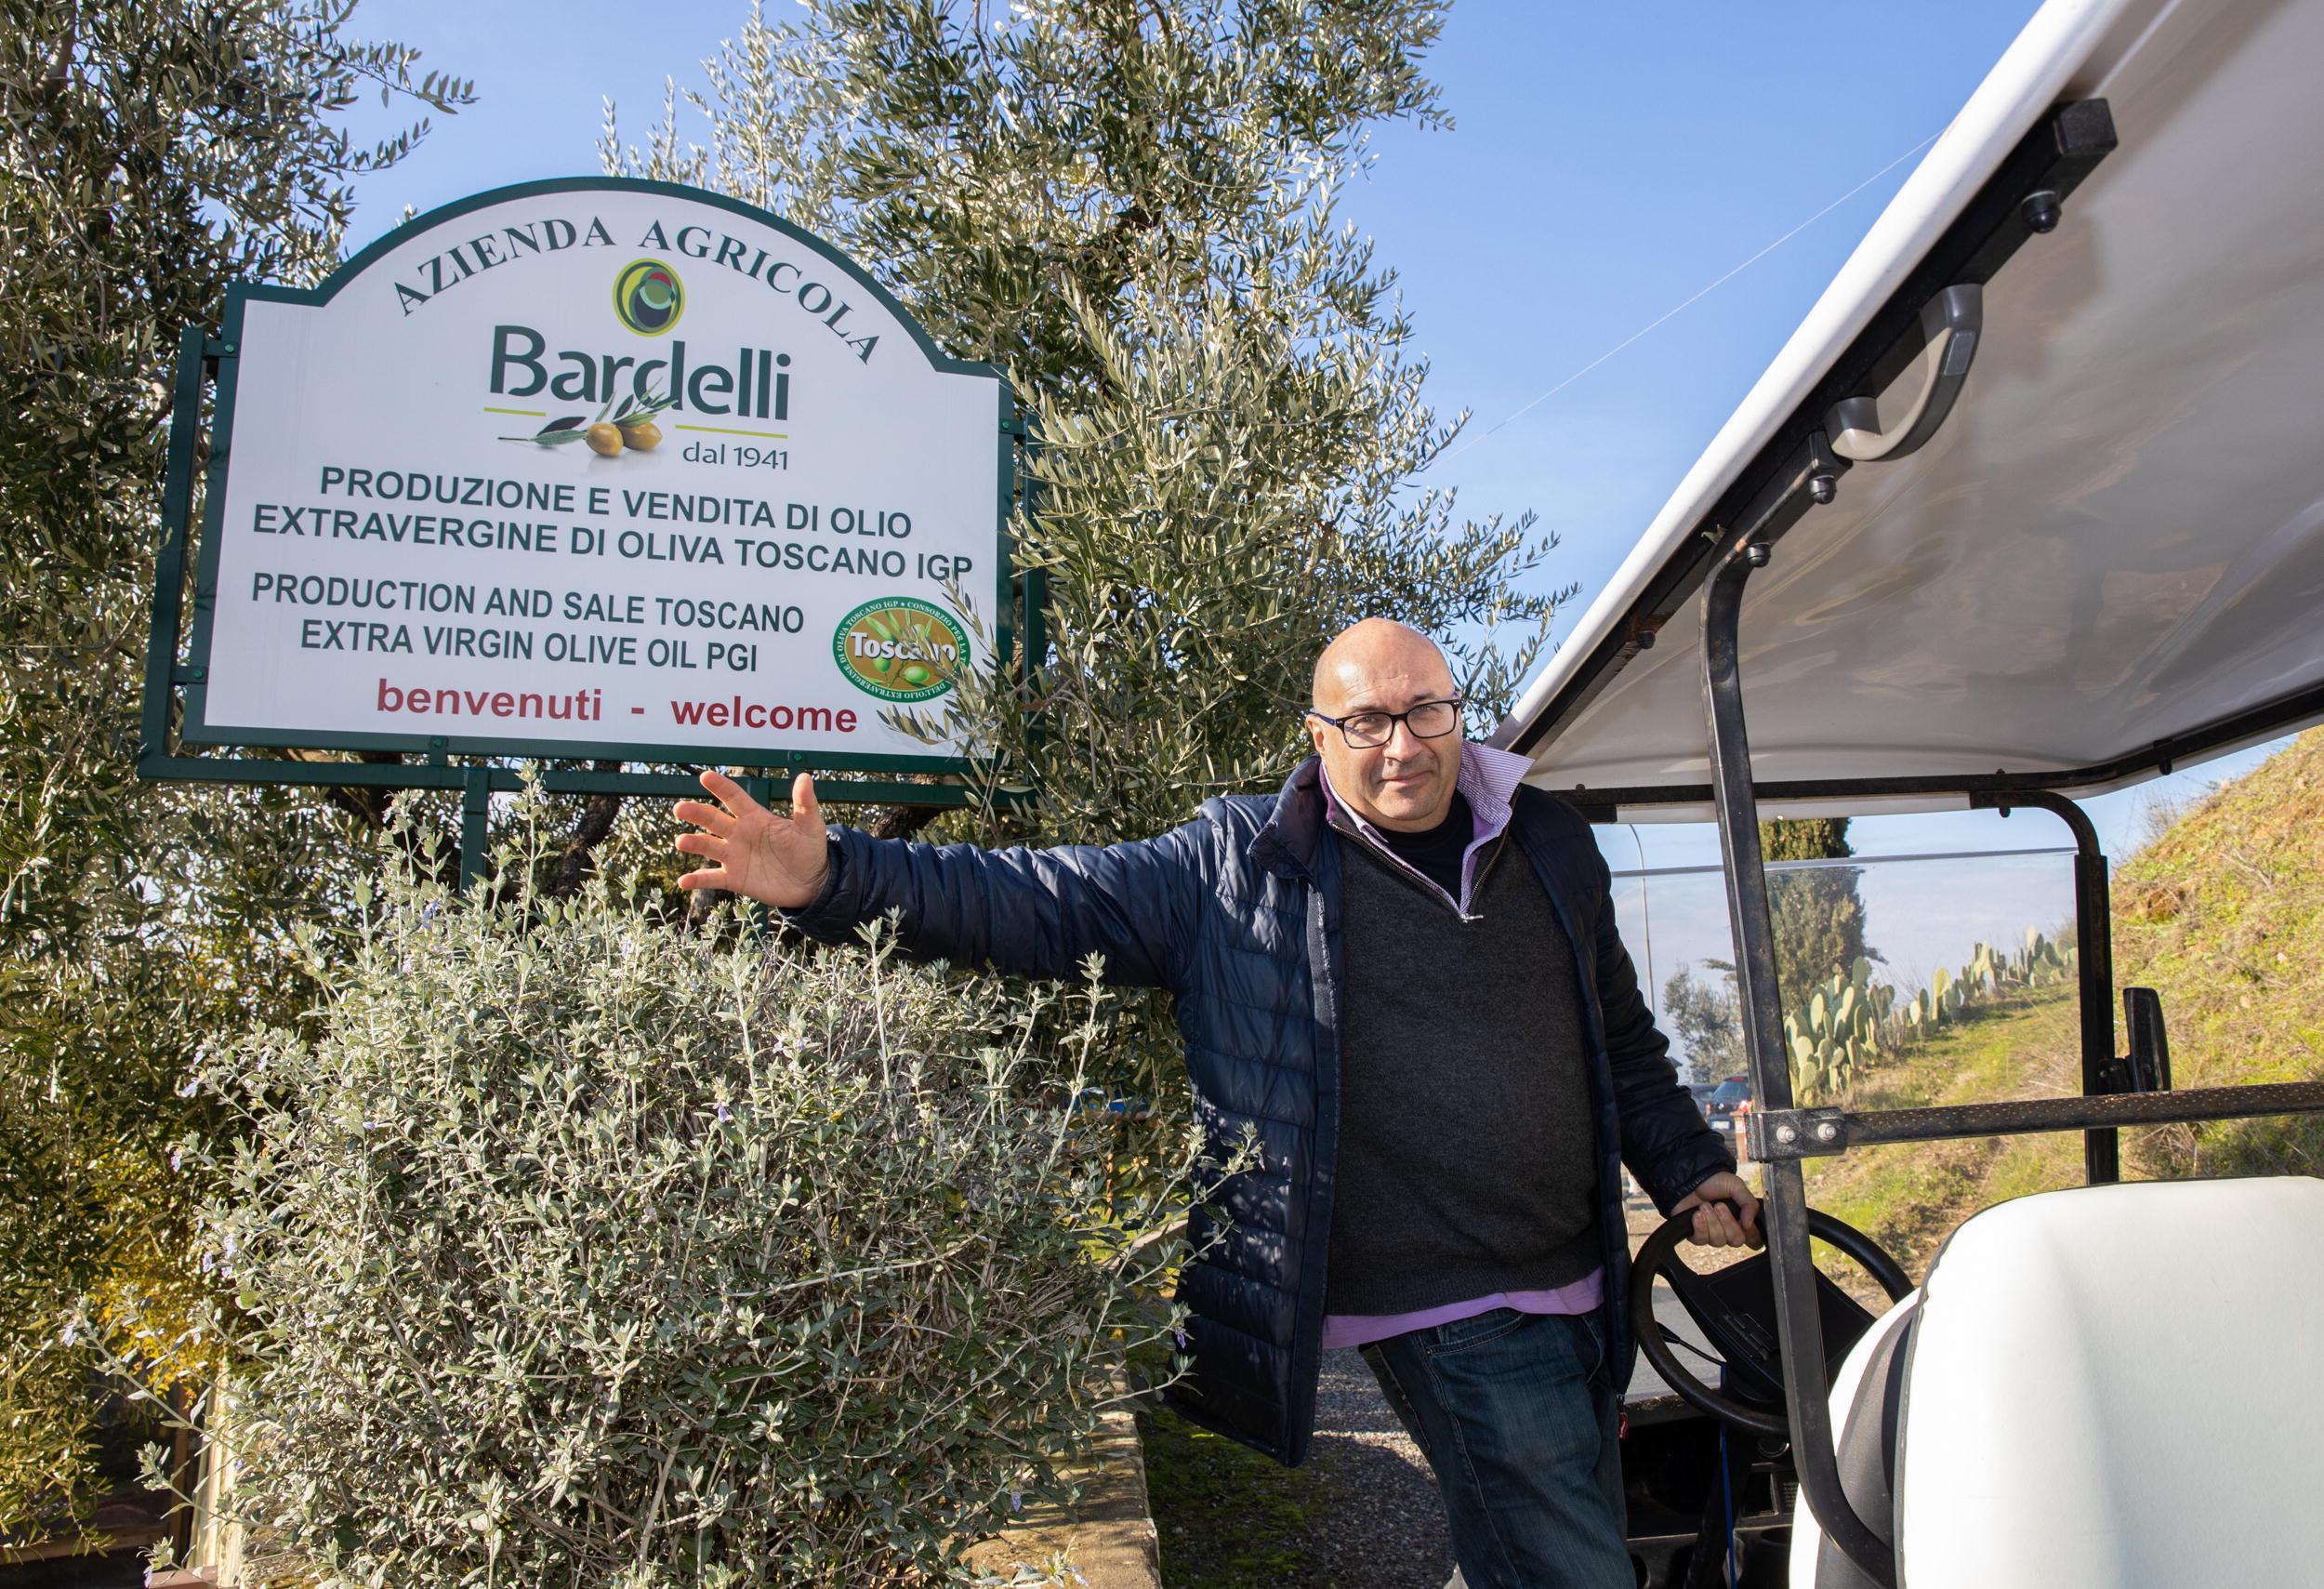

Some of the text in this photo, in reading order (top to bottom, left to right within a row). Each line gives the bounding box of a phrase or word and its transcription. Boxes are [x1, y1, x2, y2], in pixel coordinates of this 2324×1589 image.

[393, 215, 881, 365] AZIENDA AGRICOLA
[489, 324, 792, 421] Bardelli
[682, 442, 789, 470] dal 1941
[321, 466, 912, 538] PRODUZIONE E VENDITA DI OLIO
[253, 503, 973, 582] EXTRAVERGINE DI OLIVA TOSCANO IGP
[252, 572, 804, 633] PRODUCTION AND SALE TOSCANO
[846, 602, 882, 627] TOSCANO
[906, 602, 953, 627] CONSORZIO
[950, 626, 964, 642] PER
[958, 642, 967, 655] LA
[301, 619, 758, 672] EXTRA VIRGIN OLIVE OIL PGI
[837, 628, 849, 652] OLIVA
[838, 654, 847, 664] DI
[376, 678, 857, 733] benvenuti - welcome
[844, 665, 902, 699] EXTRAVERGINE
